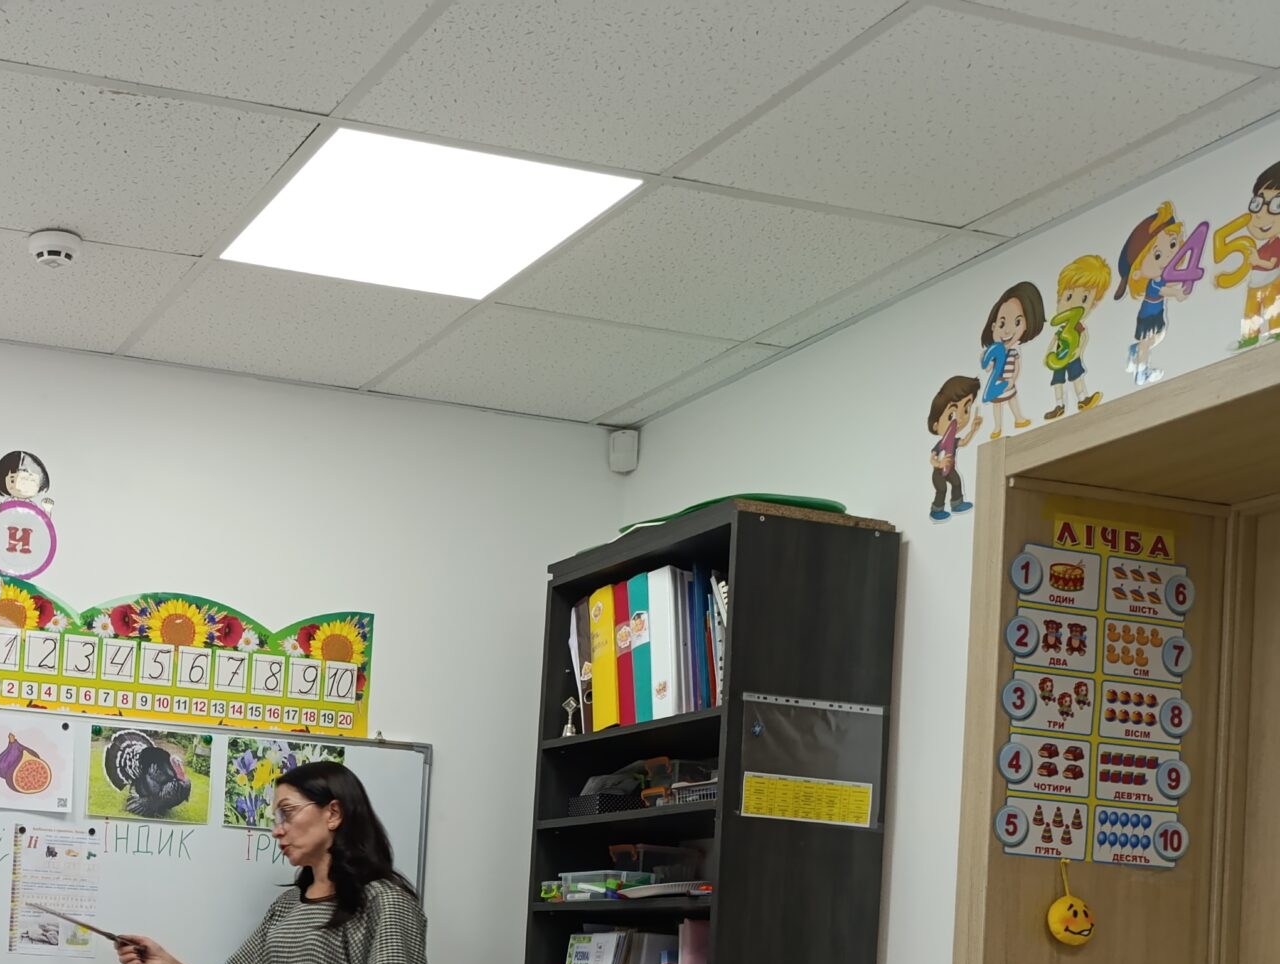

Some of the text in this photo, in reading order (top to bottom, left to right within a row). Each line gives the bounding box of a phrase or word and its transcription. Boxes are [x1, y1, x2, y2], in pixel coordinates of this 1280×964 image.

[1162, 220, 1210, 296] 4
[1213, 213, 1257, 289] 5
[1045, 305, 1085, 371] 3
[981, 342, 1009, 404] 2
[1056, 521, 1172, 559] ЛІЧБА
[1020, 561, 1031, 584] 1
[1048, 594, 1076, 606] ОДИН
[1174, 582, 1188, 606] 6
[1129, 604, 1159, 616] ШІСТЬ
[1015, 623, 1029, 648] 2
[4, 634, 355, 698] 1 2 3 4 5 6 7 8 9 10
[1048, 657, 1068, 668] ДВА
[1172, 644, 1185, 667] 7
[1133, 668, 1150, 677] СІМ
[6, 682, 14, 694] 2
[26, 684, 34, 696] 3
[44, 686, 52, 698] 4
[65, 688, 73, 700] 5
[84, 690, 92, 702] 6
[102, 692, 110, 703] 7
[121, 694, 129, 705] 8
[140, 695, 148, 707] 9
[156, 697, 169, 709] 10
[175, 698, 188, 711] 11
[192, 700, 206, 713] 12
[212, 702, 225, 714] 13
[230, 704, 244, 716] 14
[248, 705, 262, 718] 15
[266, 706, 280, 720] 16
[285, 708, 298, 722] 17
[303, 710, 316, 724] 18
[321, 712, 334, 725] 19
[338, 714, 352, 726] 20
[1012, 686, 1025, 711] 3
[1047, 720, 1065, 730] ТРИ
[1170, 704, 1183, 728] 8
[1124, 728, 1151, 739] ВІСІМ
[1007, 750, 1022, 774] 4
[1033, 782, 1072, 794] ЧОТИРИ
[1167, 767, 1181, 791] 9
[1004, 813, 1018, 837] 5
[104, 815, 196, 861] ІНДИК
[244, 829, 287, 865] ІРИ
[1159, 828, 1183, 853] 10
[1112, 853, 1150, 864] ДЕСЯТЬ
